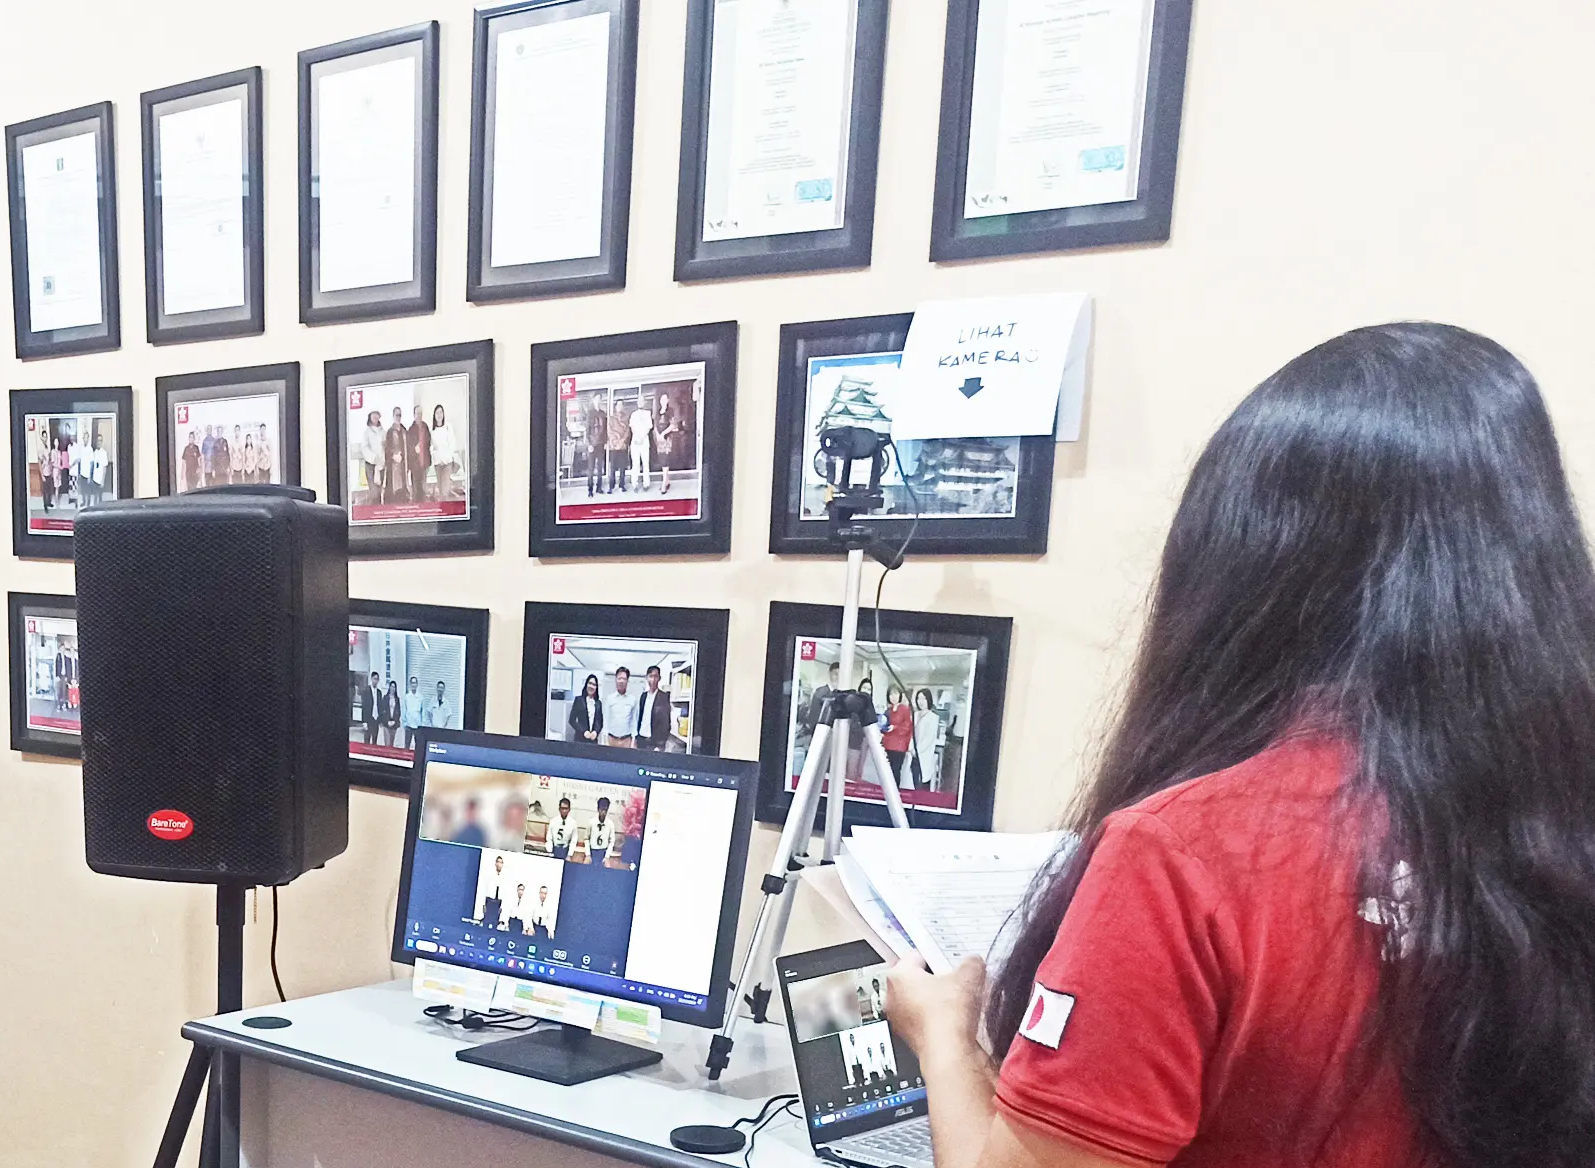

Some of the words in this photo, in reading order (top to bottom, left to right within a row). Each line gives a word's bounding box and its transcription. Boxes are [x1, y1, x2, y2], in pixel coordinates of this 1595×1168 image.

[958, 322, 1018, 344] LIHAT
[938, 349, 1020, 368] KAMERA
[151, 818, 187, 828] BareTone
[556, 828, 564, 841] 5
[596, 835, 603, 846] 6
[895, 1106, 913, 1117] ASUS
